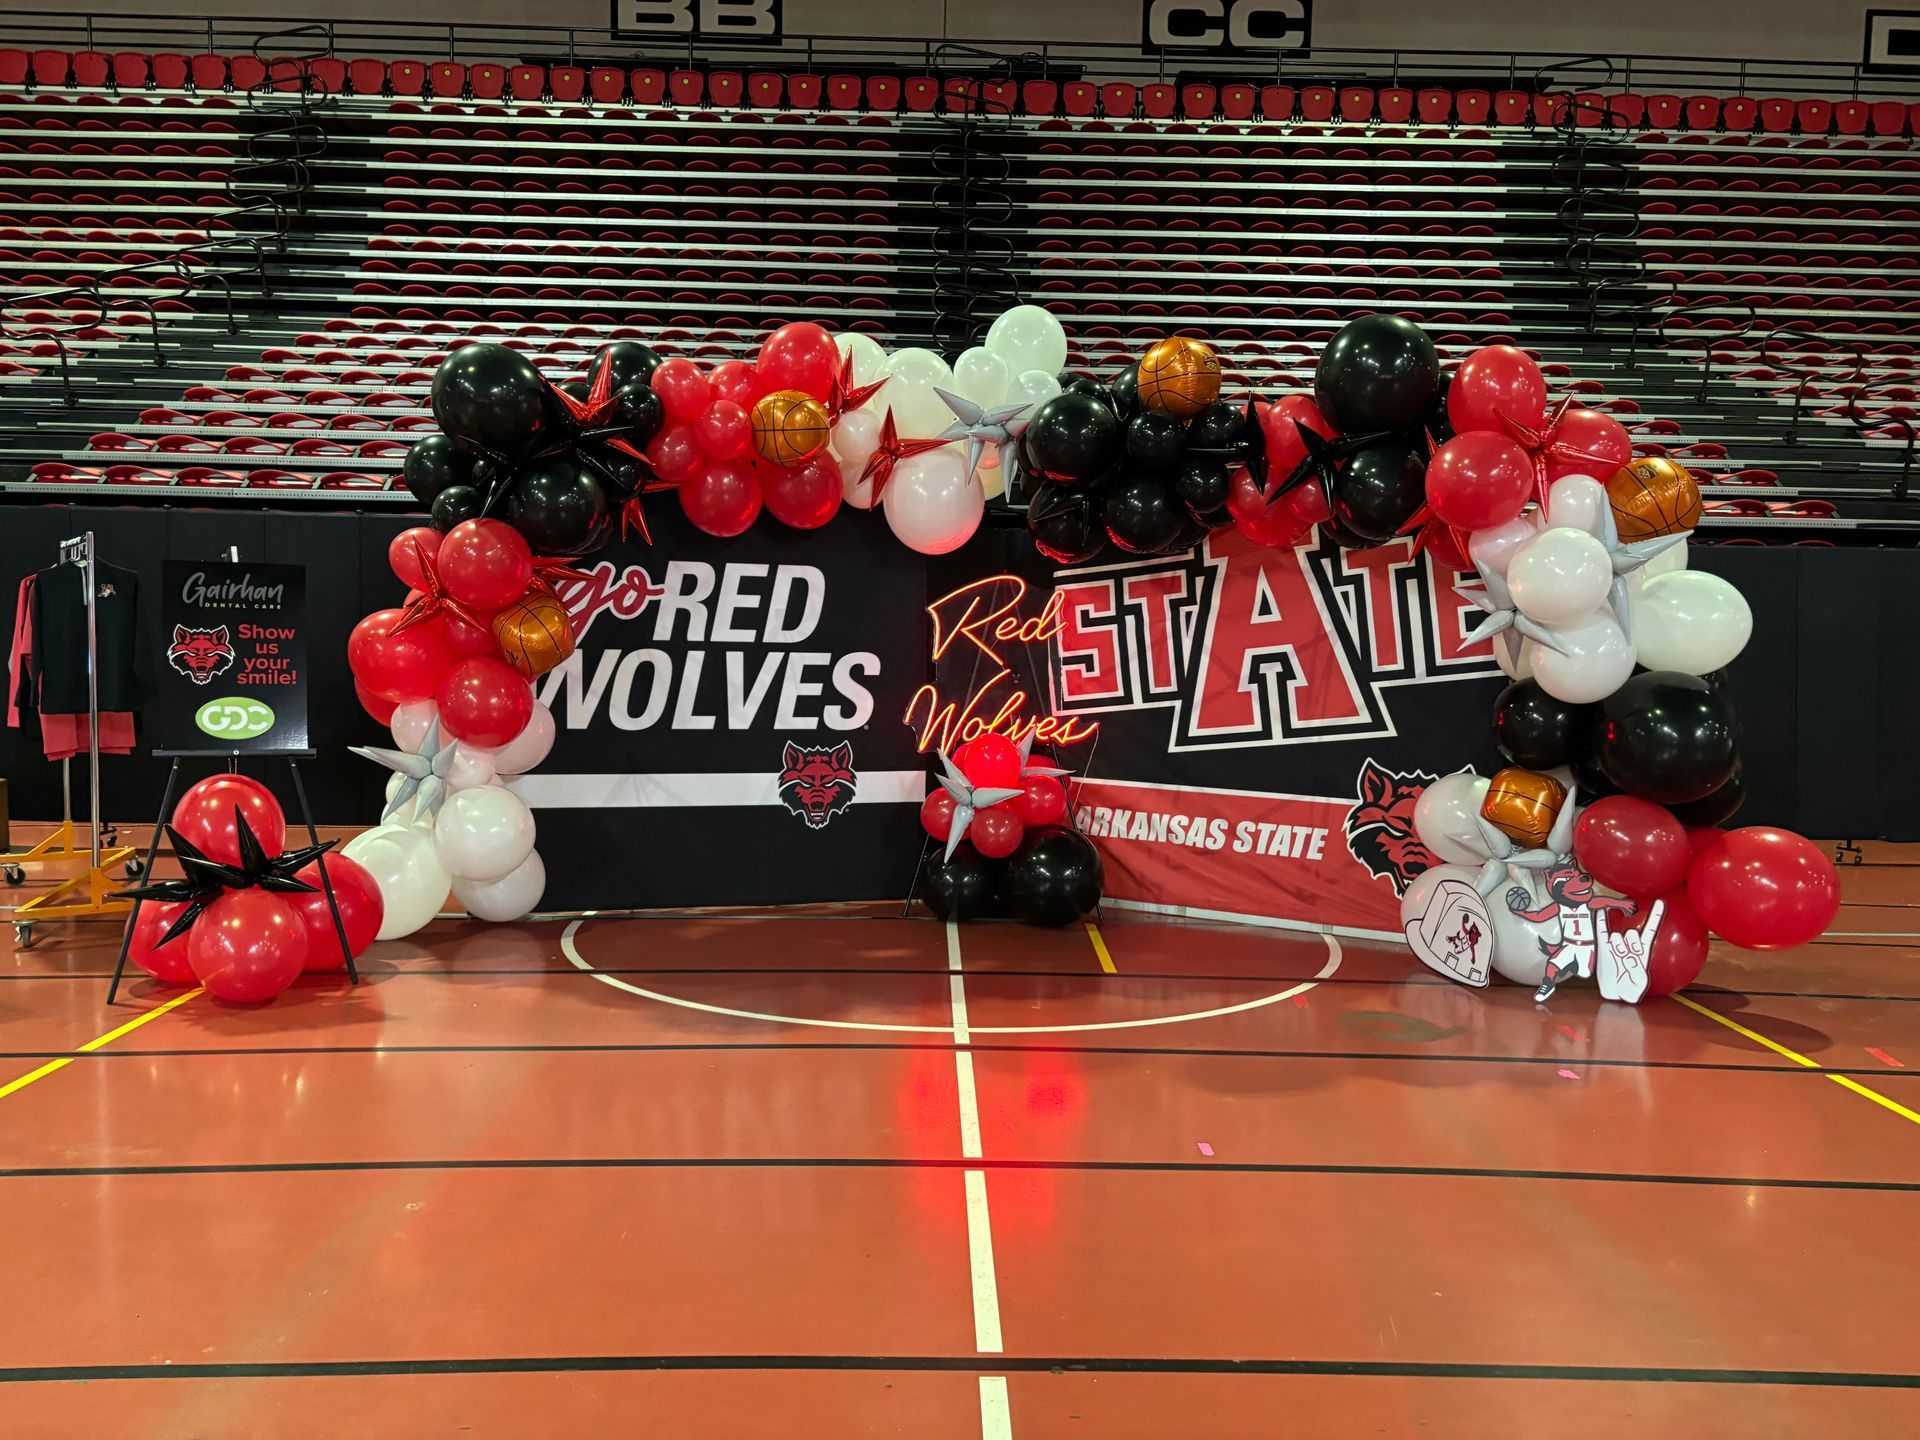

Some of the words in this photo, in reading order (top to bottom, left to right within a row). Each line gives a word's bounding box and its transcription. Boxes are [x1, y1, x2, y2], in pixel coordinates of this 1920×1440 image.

[1149, 0, 1304, 50] CC
[182, 572, 284, 607] Gairhan
[552, 561, 666, 646] go
[652, 560, 825, 643] RED
[238, 623, 295, 640] Show
[926, 574, 1067, 666] Red
[244, 657, 290, 673] your
[255, 642, 279, 655] us
[237, 670, 297, 685] smile!
[534, 648, 881, 731] WOLVES
[202, 705, 268, 731] GDC
[903, 668, 1099, 756] Wolves
[1075, 806, 1228, 851] ARKANSAS
[1232, 821, 1329, 861] STATE
[1573, 920, 1582, 936] 1
